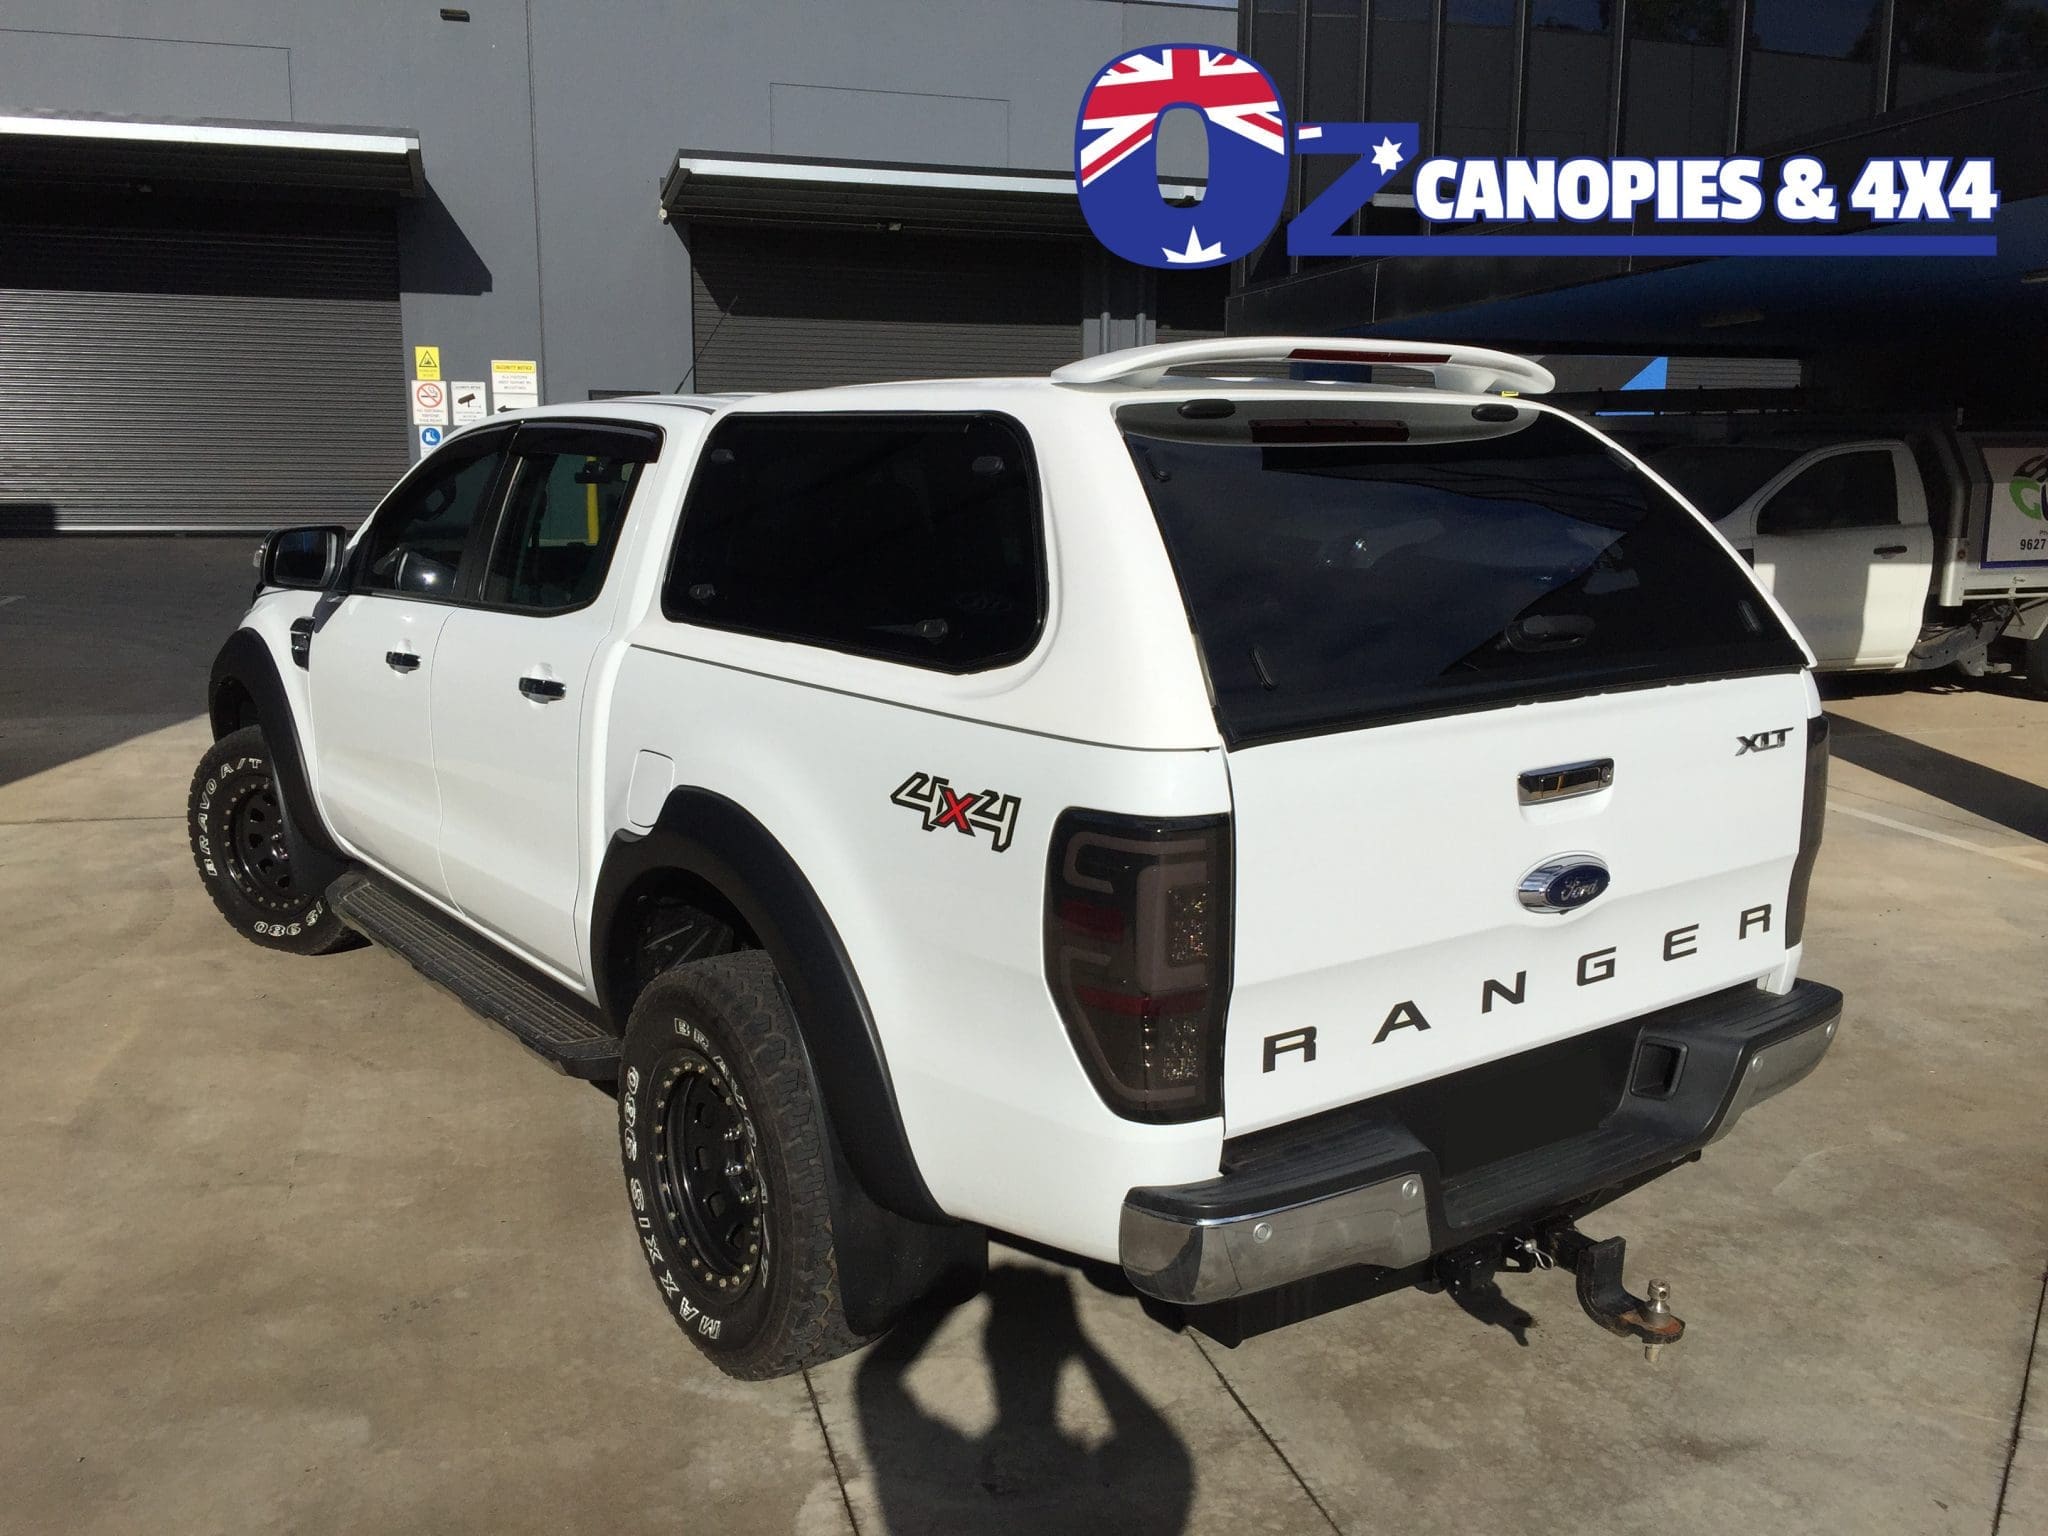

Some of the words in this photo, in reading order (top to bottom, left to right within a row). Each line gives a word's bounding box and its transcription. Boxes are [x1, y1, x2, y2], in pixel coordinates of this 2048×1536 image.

[2020, 538, 2047, 550] 9627
[1735, 726, 1795, 757] XLT
[197, 777, 218, 877] BRAVO
[219, 757, 263, 779] A/T
[1262, 903, 1772, 1074] RANGER
[674, 1016, 758, 1148] BRAVO
[630, 1177, 722, 1340] MAXXIS
